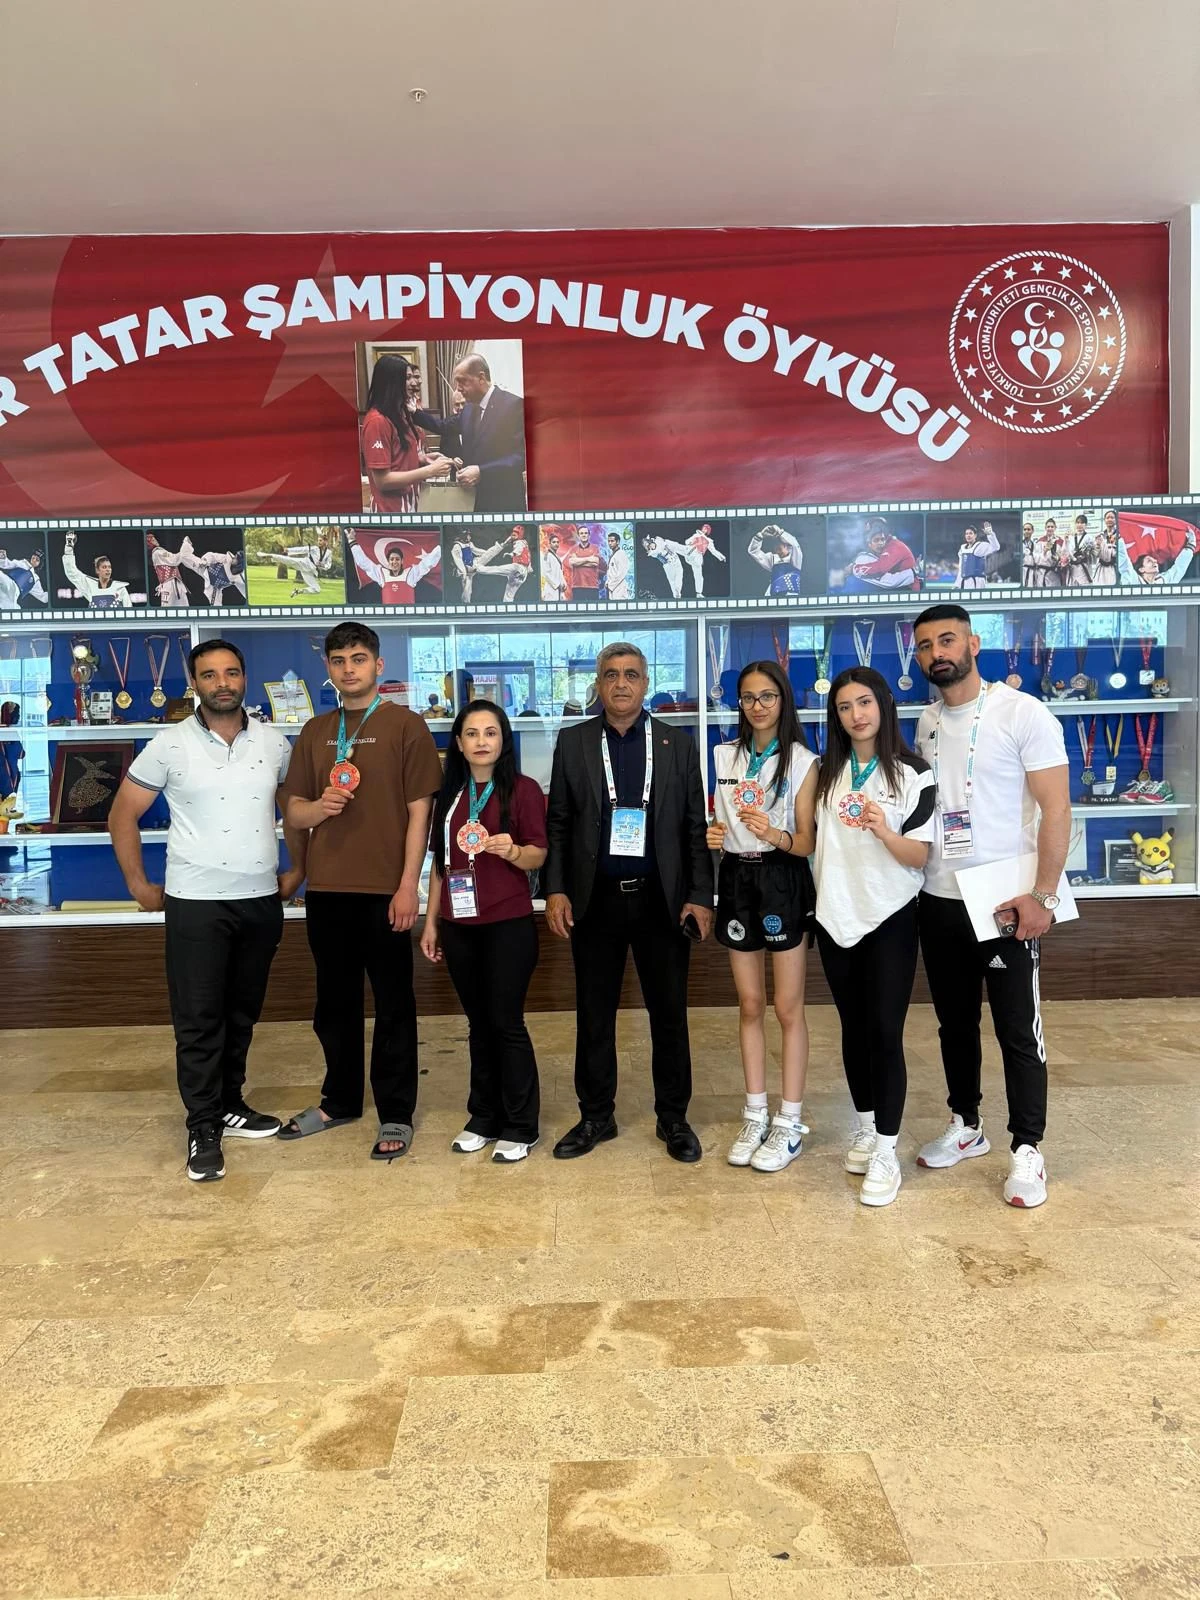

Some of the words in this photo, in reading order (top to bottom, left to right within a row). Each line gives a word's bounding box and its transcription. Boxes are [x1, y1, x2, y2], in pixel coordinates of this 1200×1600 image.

[1021, 284, 1070, 302] GENÇLİK
[1069, 297, 1083, 313] VE
[981, 288, 1020, 360] CUMHURİYETİ
[1079, 312, 1094, 347] SPOR
[23, 295, 234, 394] TATAR
[243, 262, 713, 350] ŞAMPİYONLUK
[723, 302, 972, 462] ÖYKÜSÜ
[986, 360, 1025, 398] TÜRKİYE
[1052, 346, 1095, 398] BAKANLIĞI
